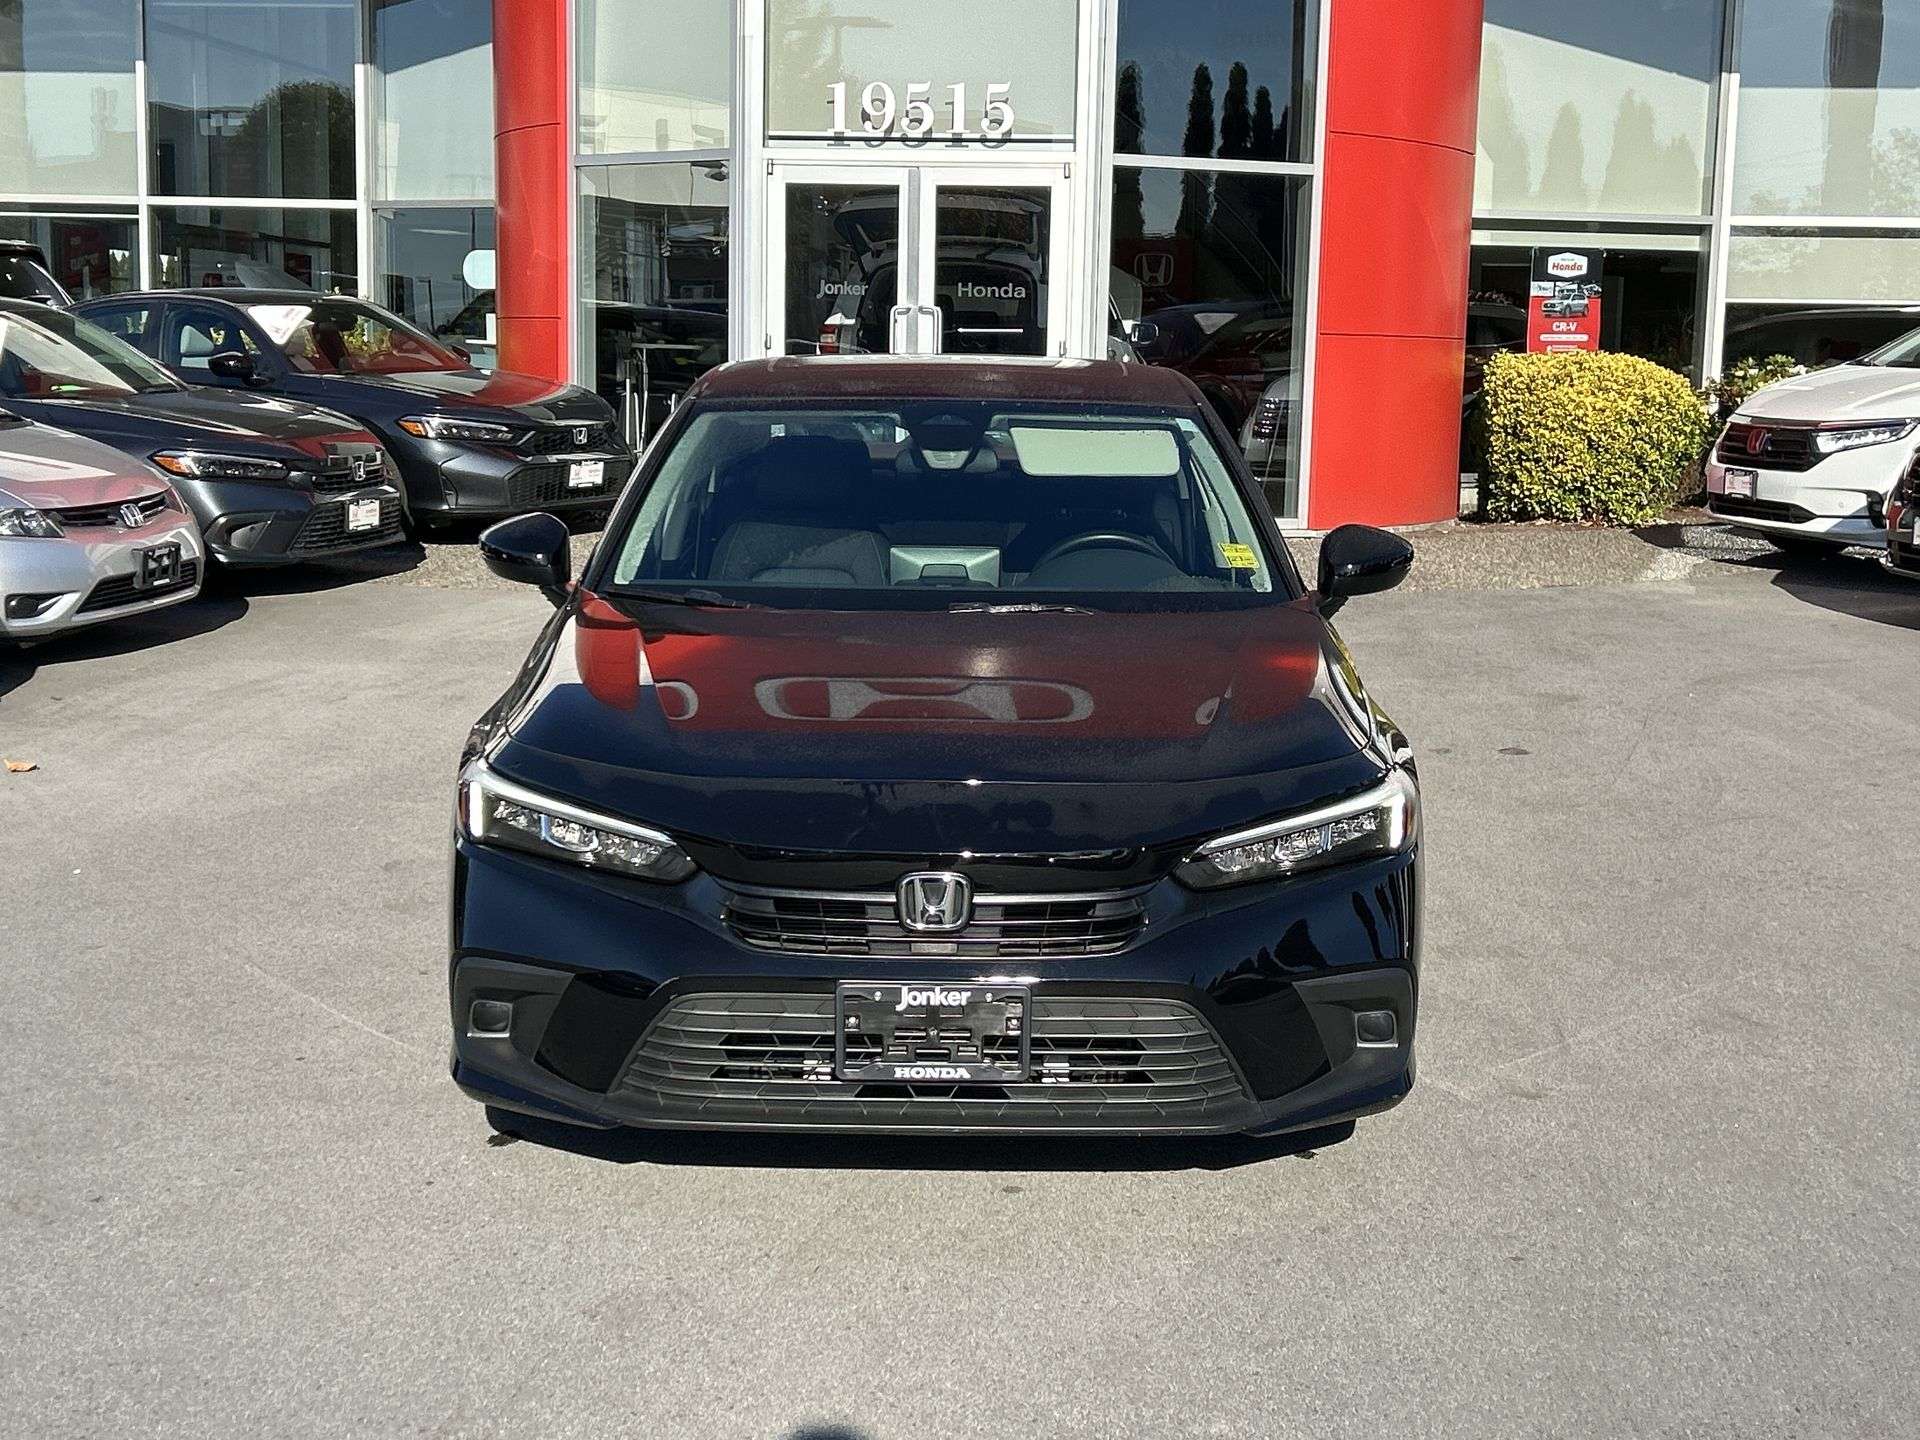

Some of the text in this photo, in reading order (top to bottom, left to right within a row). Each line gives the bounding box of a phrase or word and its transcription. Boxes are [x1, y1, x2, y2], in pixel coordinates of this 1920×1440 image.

[826, 81, 1015, 134] 19515
[1551, 261, 1584, 271] Honda
[816, 279, 1026, 299] Jonker Honda
[1551, 321, 1578, 332] CR-V
[895, 985, 972, 1012] Jonker
[894, 1066, 971, 1079] HONDA
